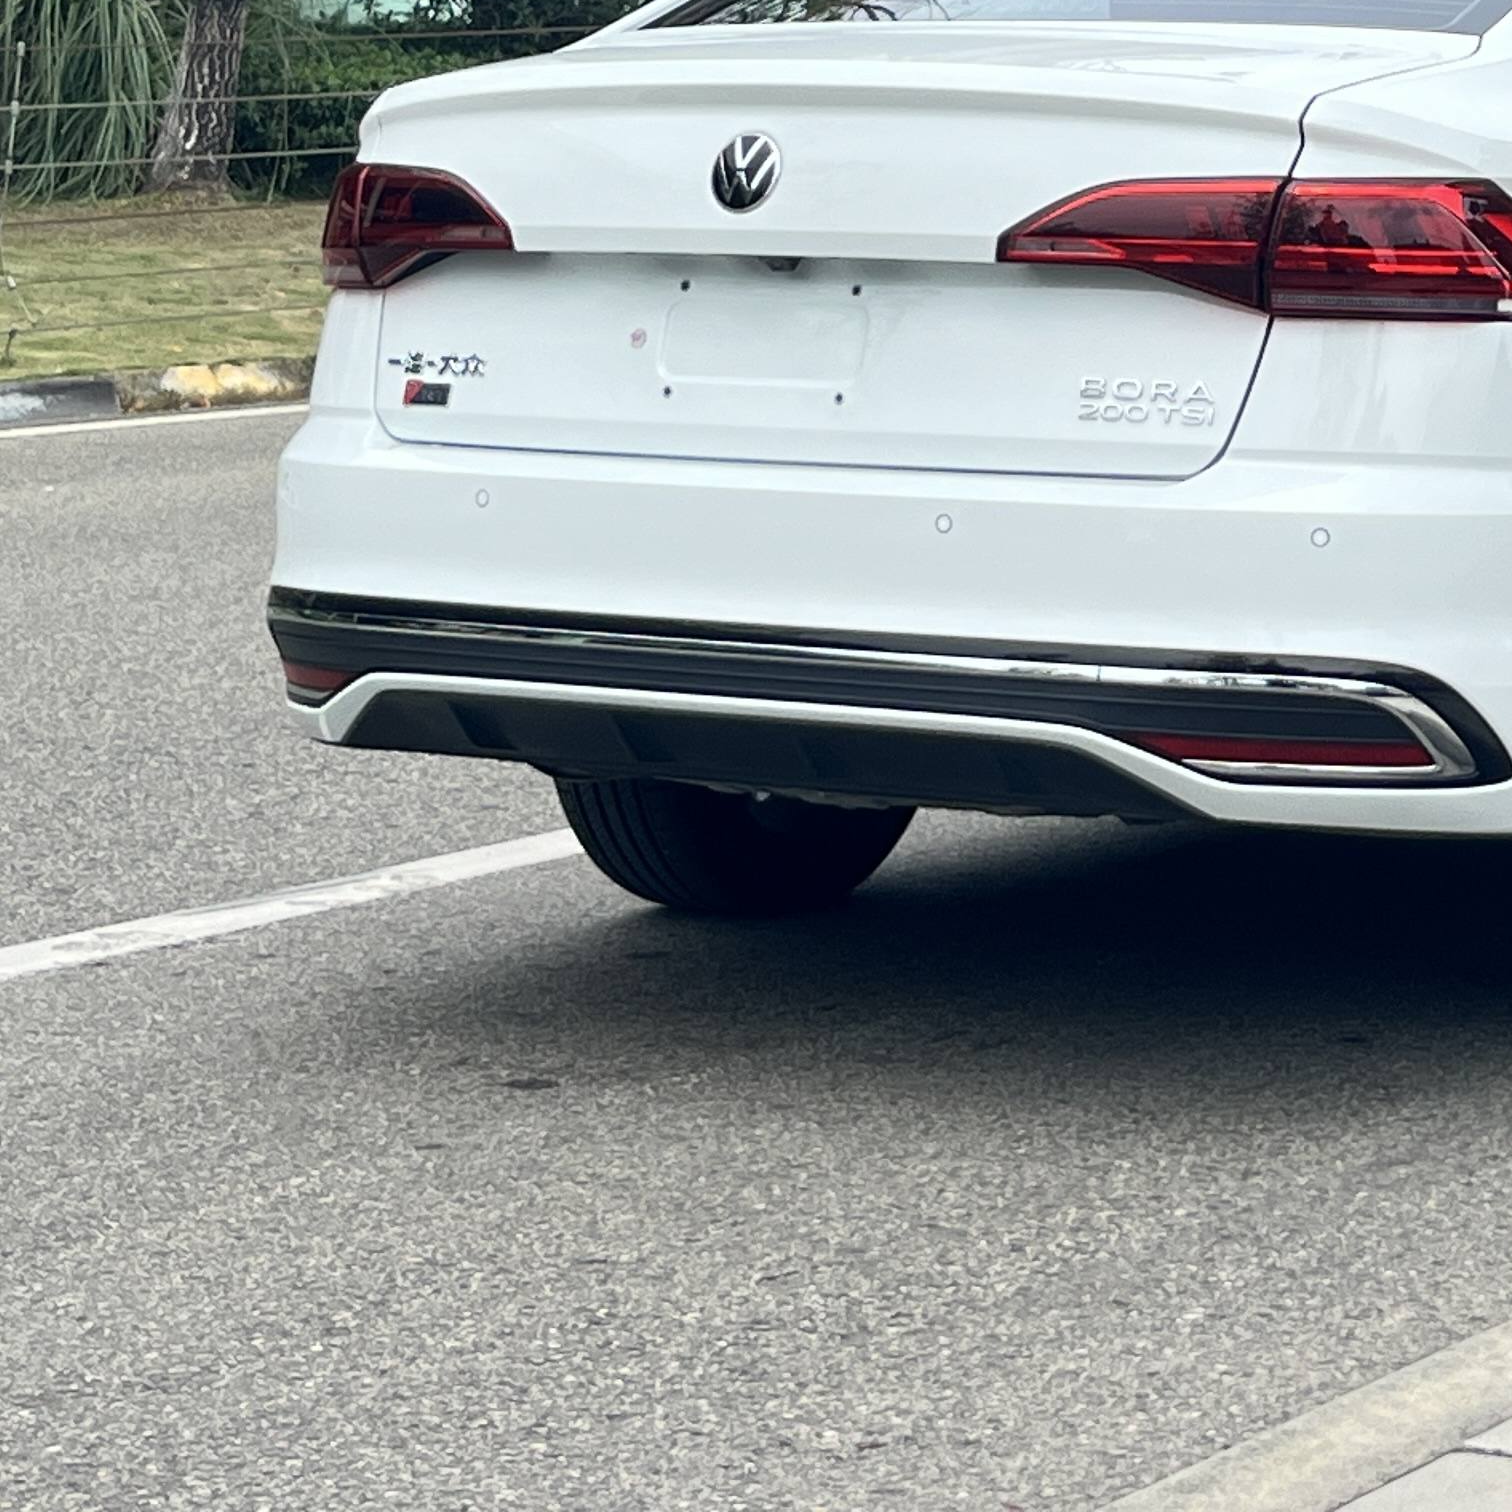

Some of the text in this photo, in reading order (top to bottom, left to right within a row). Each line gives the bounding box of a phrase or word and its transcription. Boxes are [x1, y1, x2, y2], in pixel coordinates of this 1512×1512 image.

[1080, 377, 1215, 404] BORA
[1078, 402, 1216, 427] 200 TSI
